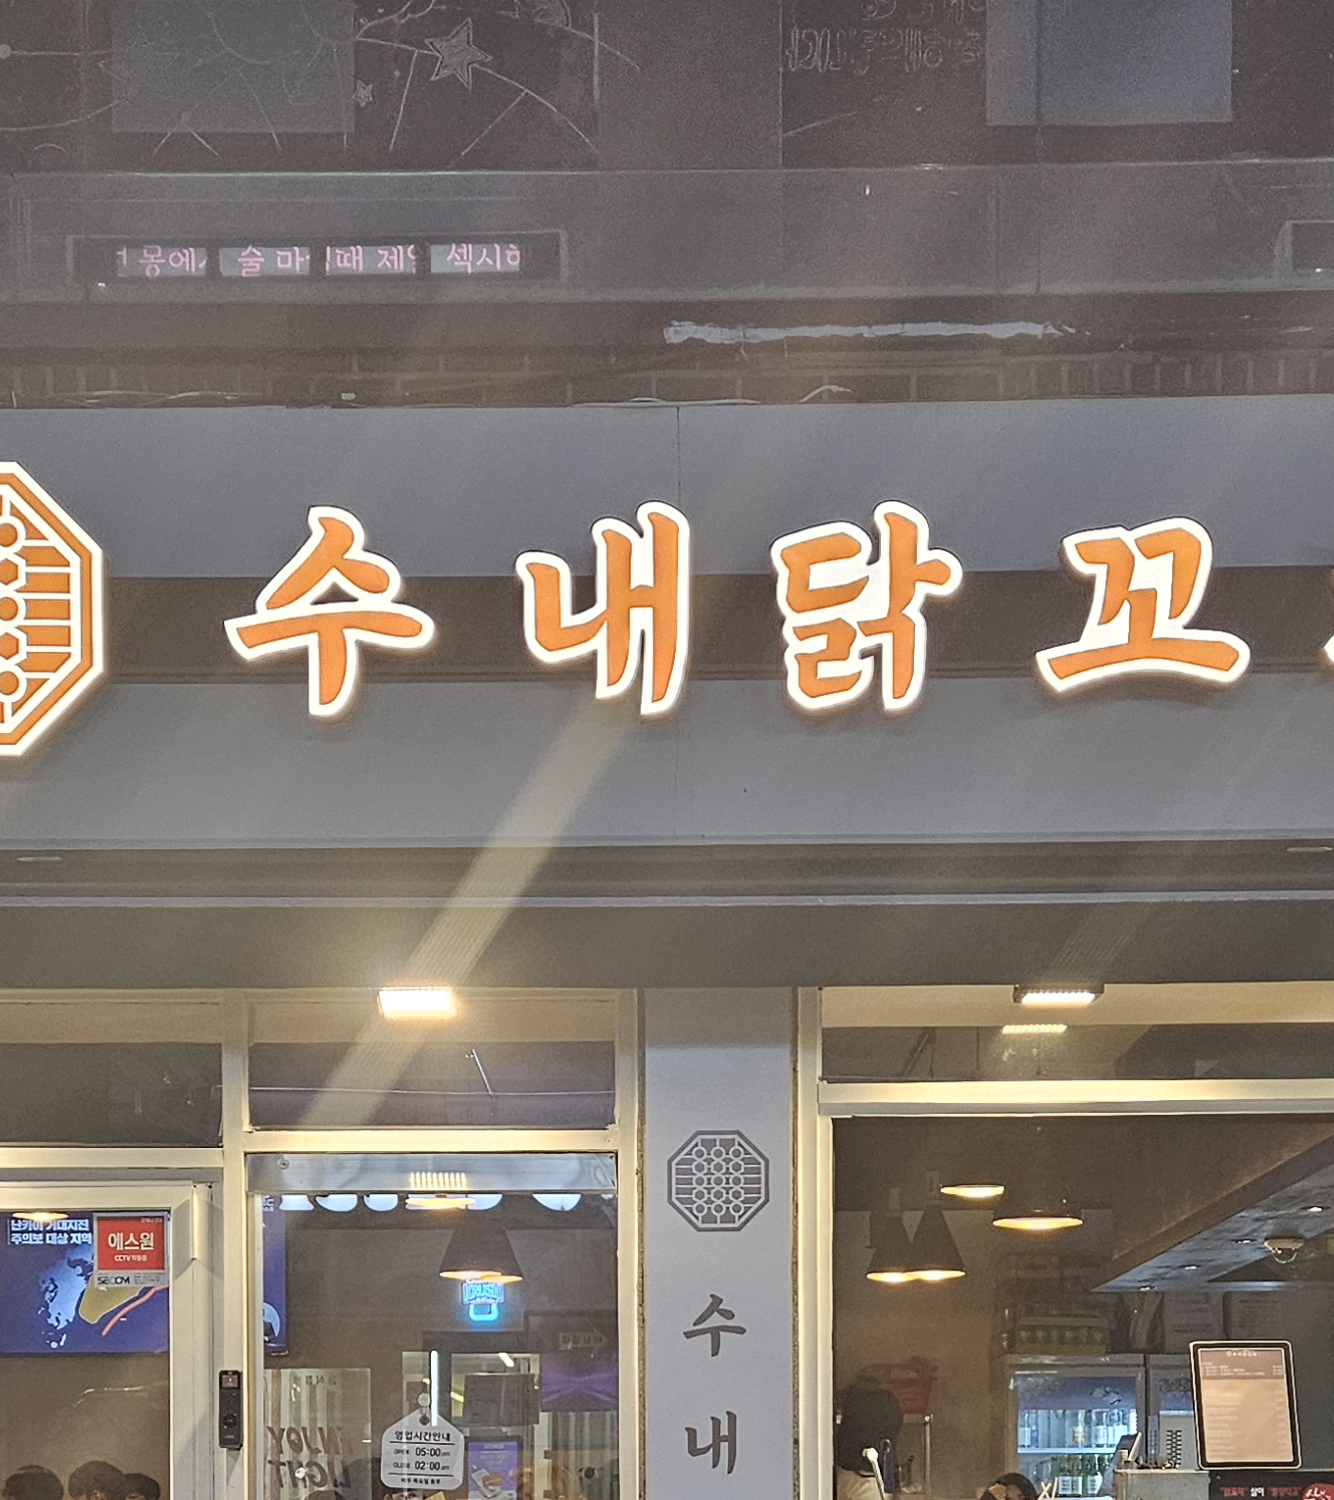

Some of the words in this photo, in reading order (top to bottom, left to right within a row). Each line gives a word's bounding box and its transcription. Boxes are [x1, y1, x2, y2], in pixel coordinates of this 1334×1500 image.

[238, 245, 264, 277] 술
[11, 1232, 43, 1245] 주의보
[46, 1233, 69, 1245] 대상
[70, 1233, 93, 1245] 지역
[107, 1232, 155, 1251] 에스원
[97, 1275, 130, 1285] SECOM
[395, 1431, 451, 1441] 영업시간안내
